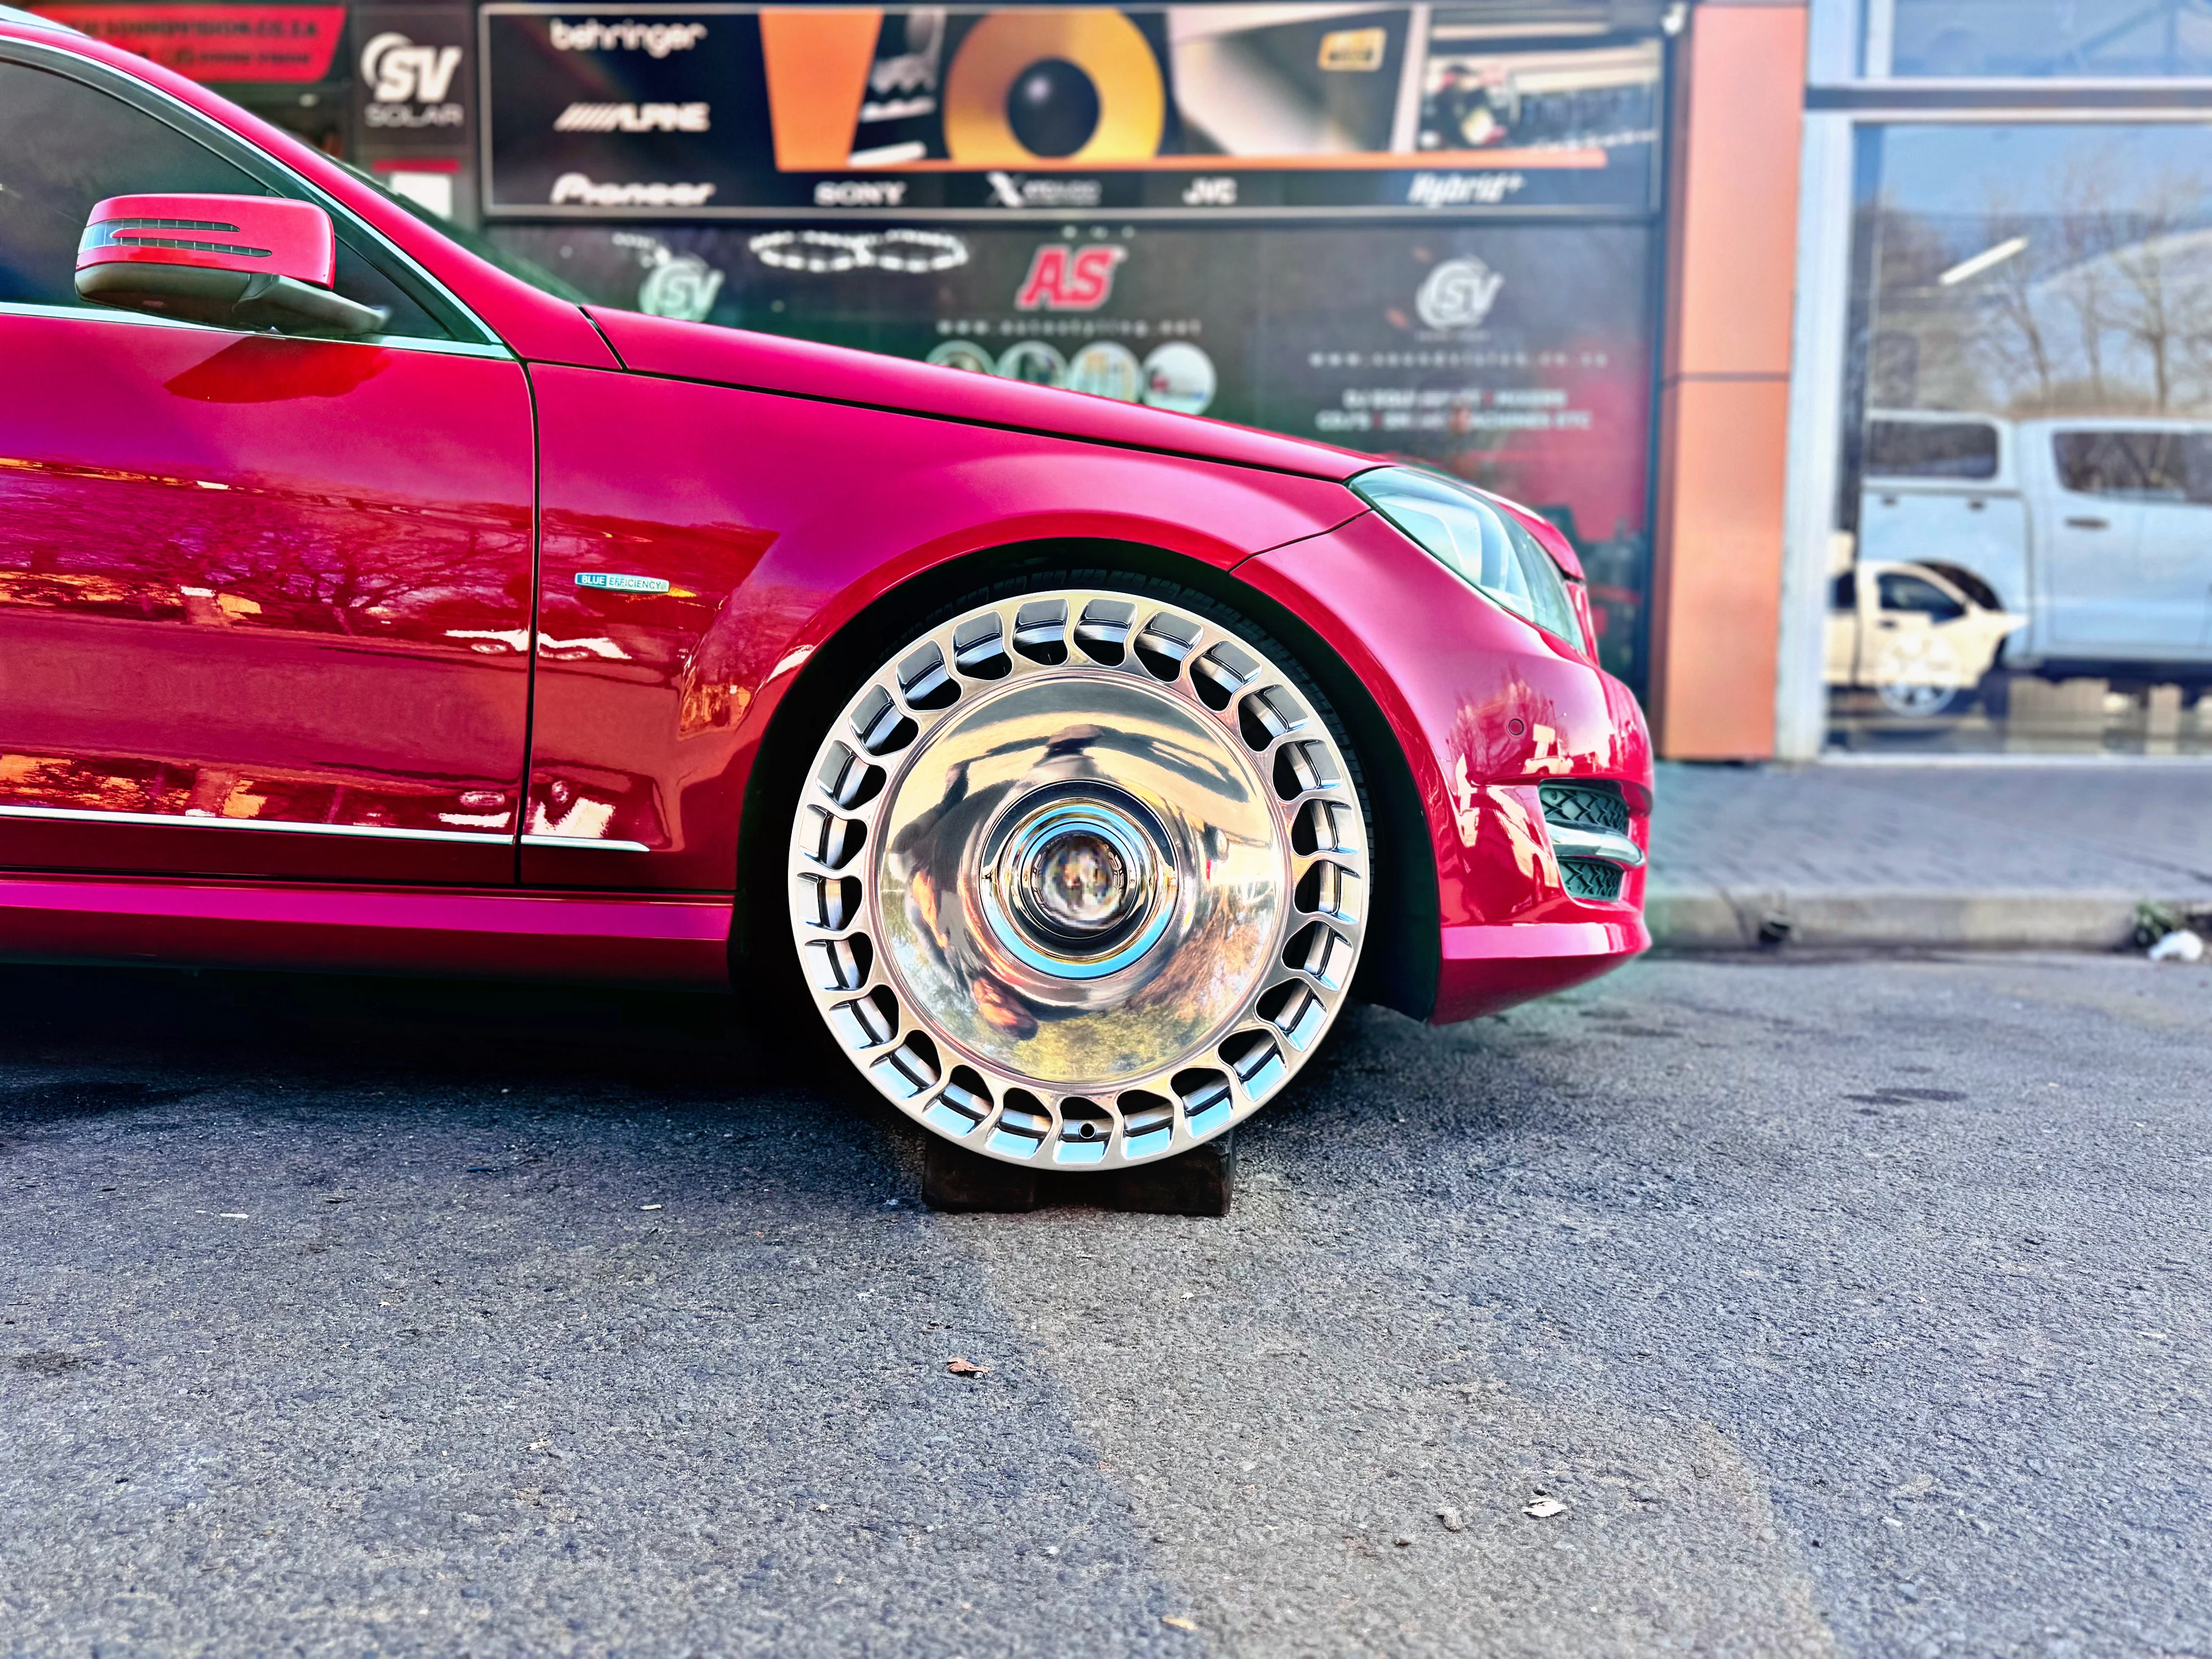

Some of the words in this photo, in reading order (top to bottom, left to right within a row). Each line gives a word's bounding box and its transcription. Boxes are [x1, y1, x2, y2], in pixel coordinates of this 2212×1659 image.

[550, 18, 707, 59] behringer
[374, 45, 463, 103] SV
[364, 103, 465, 128] SOLAR
[550, 173, 716, 205] Pioneer
[814, 180, 907, 206] SONY
[1015, 245, 1123, 311] AS
[581, 575, 606, 585] BLUE
[609, 577, 661, 589] EFFICIENCY
